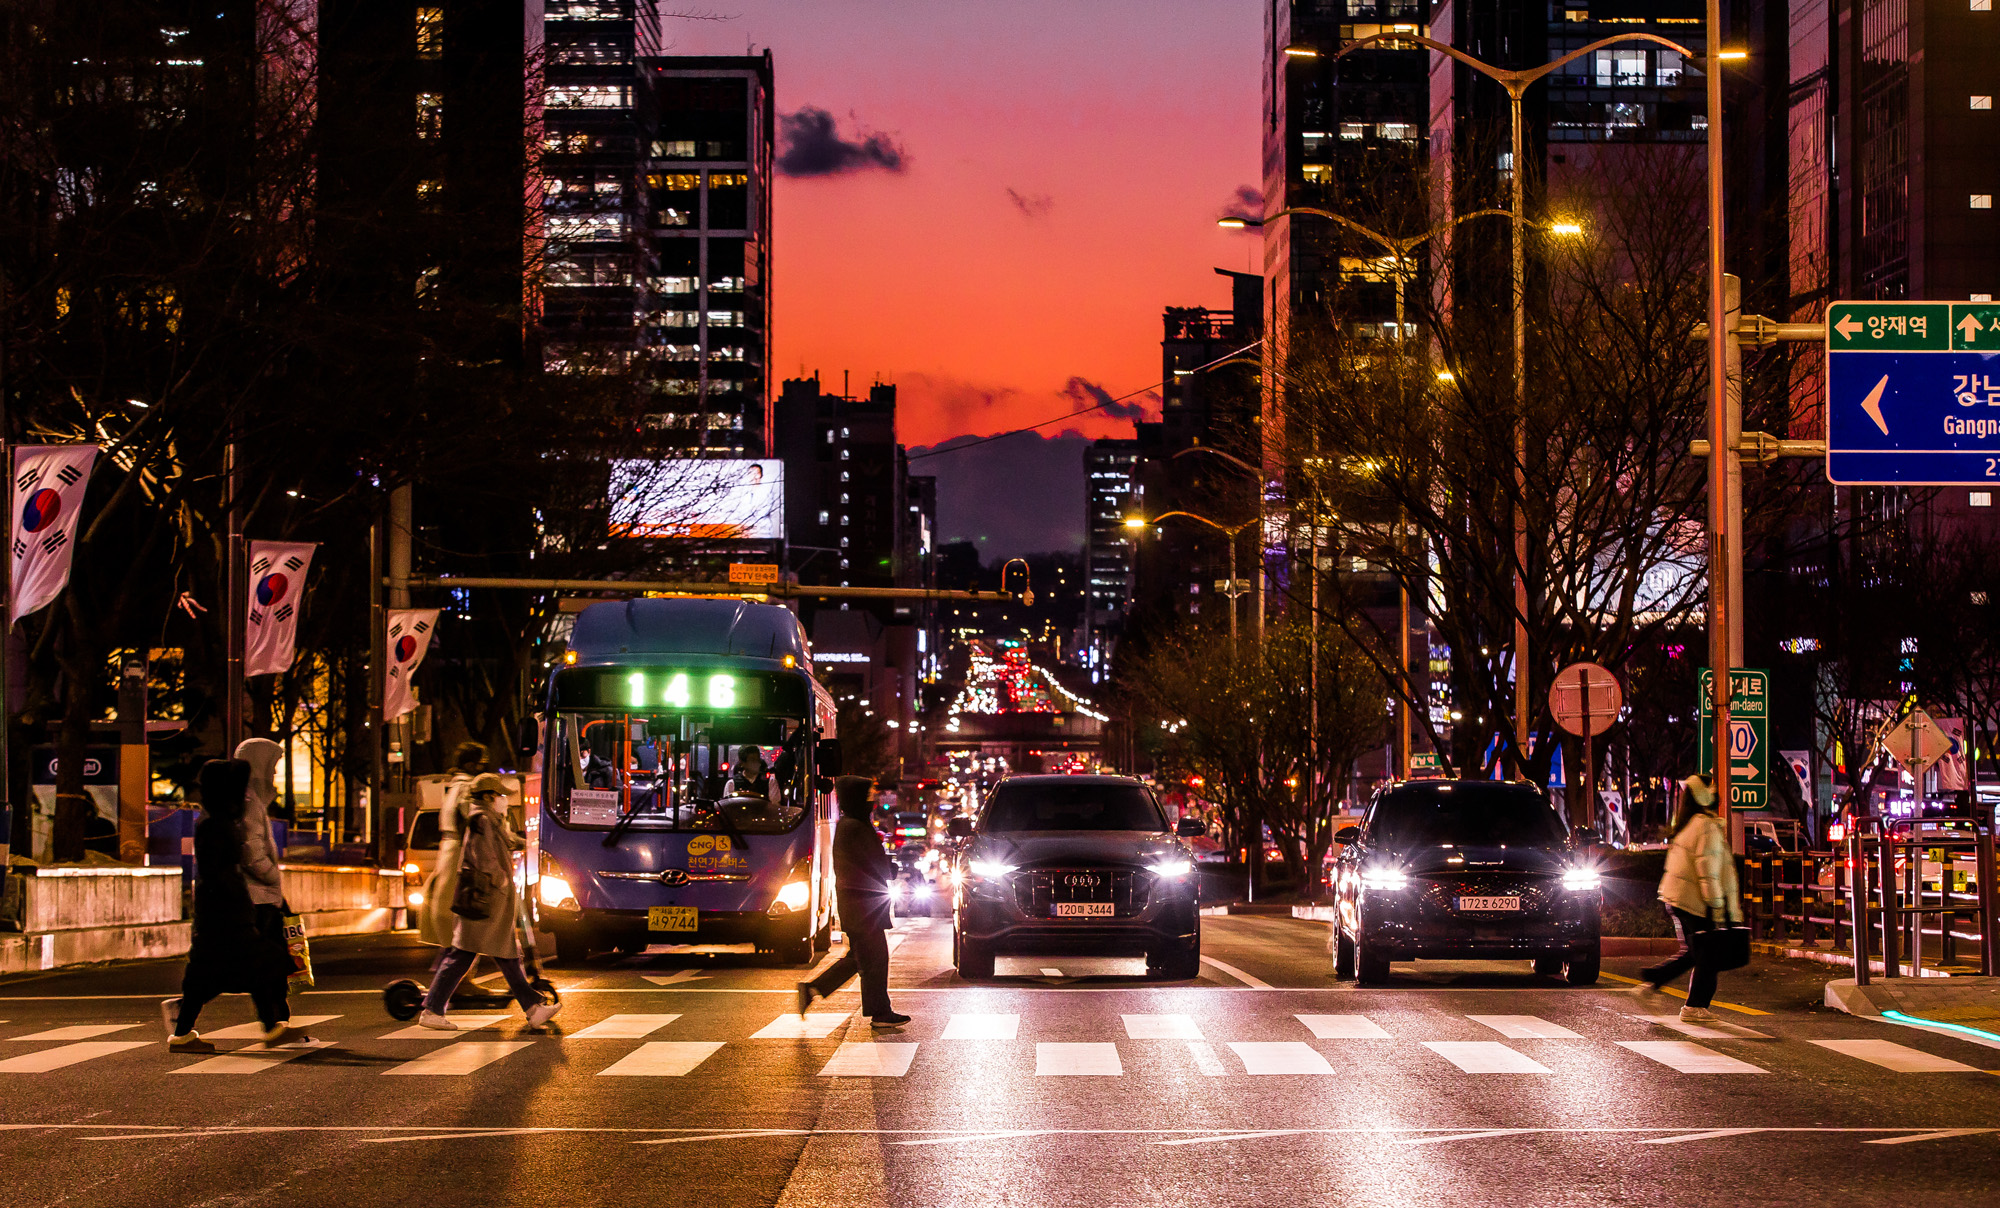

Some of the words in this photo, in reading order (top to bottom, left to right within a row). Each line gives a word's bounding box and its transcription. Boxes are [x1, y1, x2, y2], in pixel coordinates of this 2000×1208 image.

[1868, 316, 1927, 339] 양재역
[1943, 415, 2000, 439] Gangn
[1985, 458, 2000, 476] 2
[731, 572, 753, 580] CCTV
[627, 673, 735, 707] 146
[1706, 677, 1763, 696] 대로
[690, 841, 712, 849] CNG
[688, 856, 748, 868] 천연가스버스
[1087, 904, 1112, 915] 3444
[1491, 898, 1517, 908] 6290
[661, 916, 696, 929] 9744
